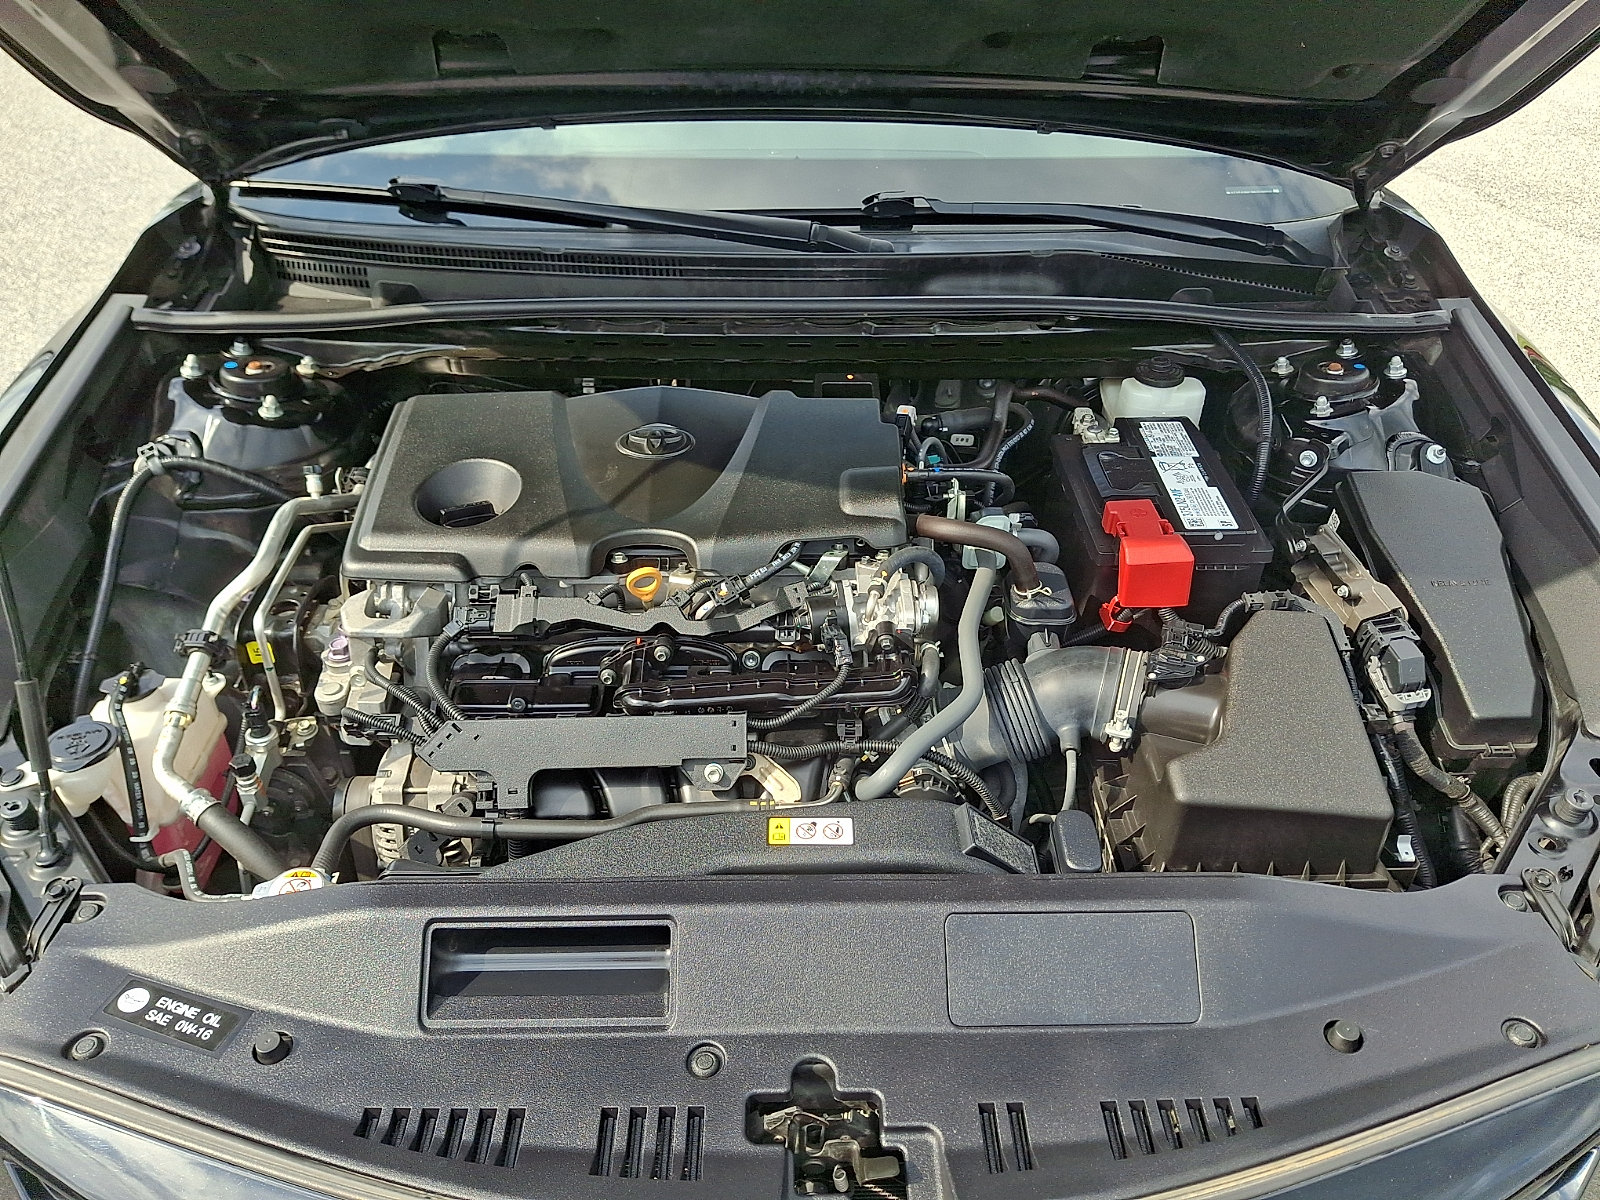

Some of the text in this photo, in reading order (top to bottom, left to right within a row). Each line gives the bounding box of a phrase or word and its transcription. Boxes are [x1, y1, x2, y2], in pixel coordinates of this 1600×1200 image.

[144, 1010, 214, 1040] SAE 0W-16
[155, 996, 222, 1028] ENGINE OIL
